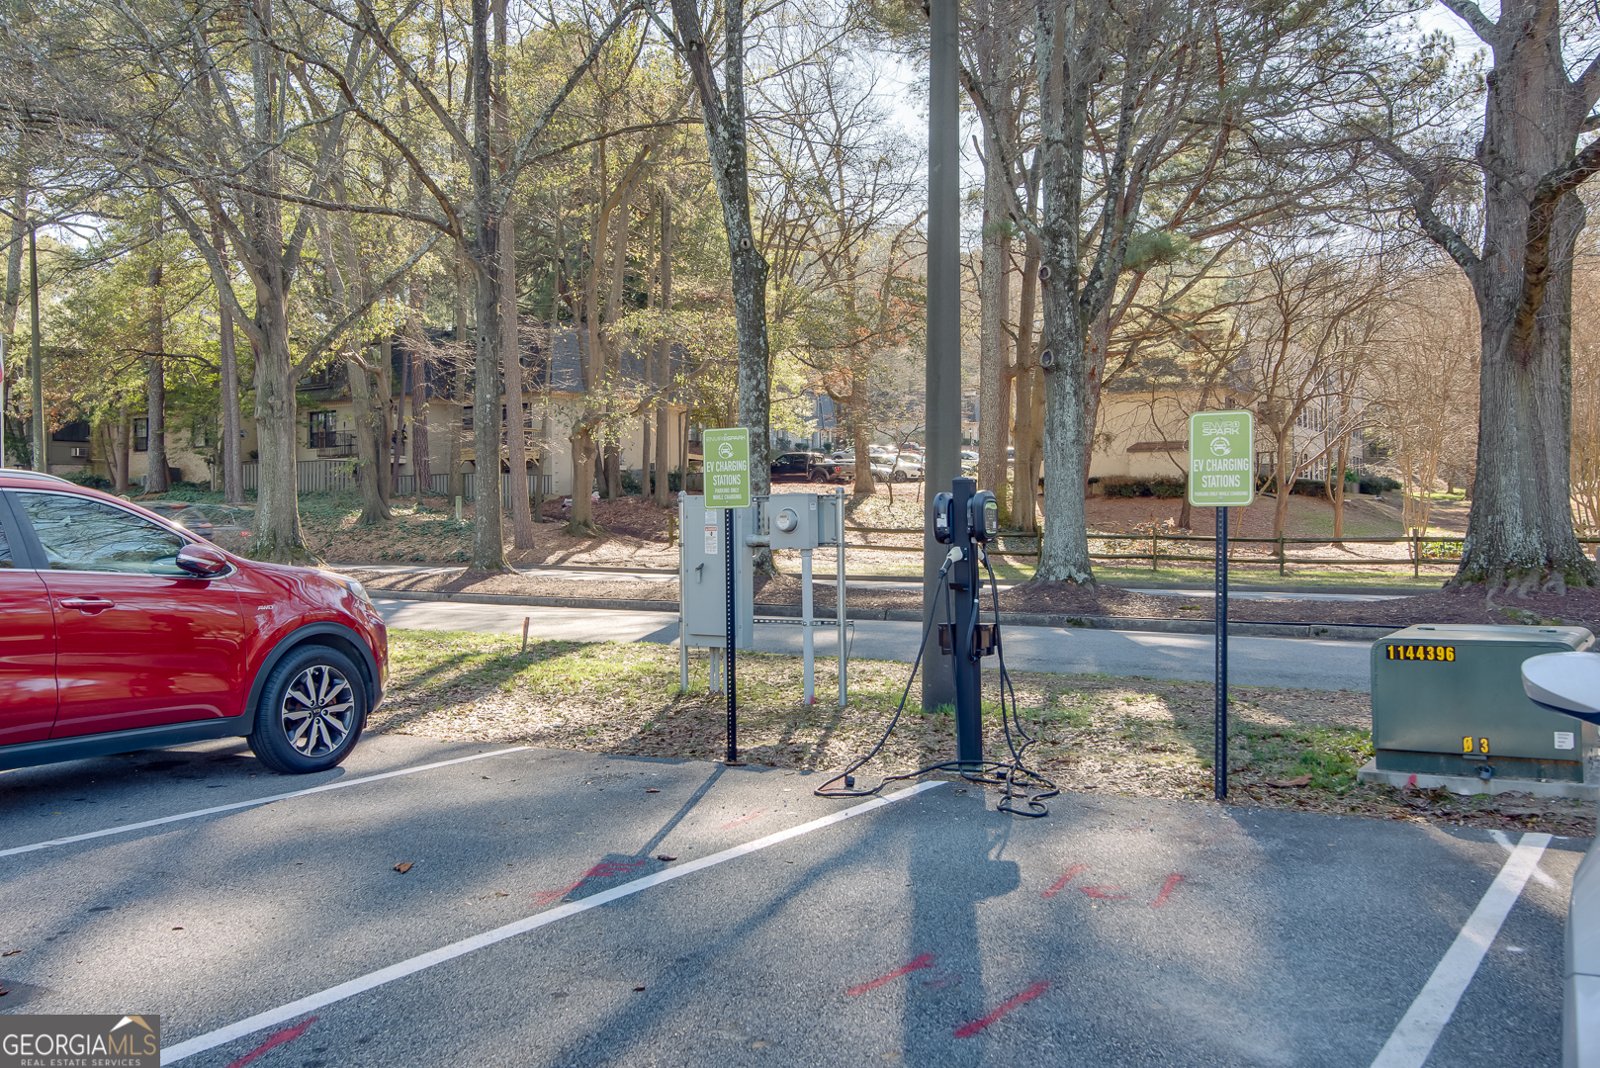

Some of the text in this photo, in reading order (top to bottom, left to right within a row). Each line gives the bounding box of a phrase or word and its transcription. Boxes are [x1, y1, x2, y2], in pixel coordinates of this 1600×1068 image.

[1202, 427, 1240, 436] SPARK
[706, 460, 747, 472] EV CHARGING
[1193, 458, 1249, 472] EV CHARGING
[713, 474, 741, 486] STATIONS
[1201, 475, 1240, 488] STATIONS
[1387, 645, 1455, 661] 1144396
[1480, 737, 1489, 753] 3
